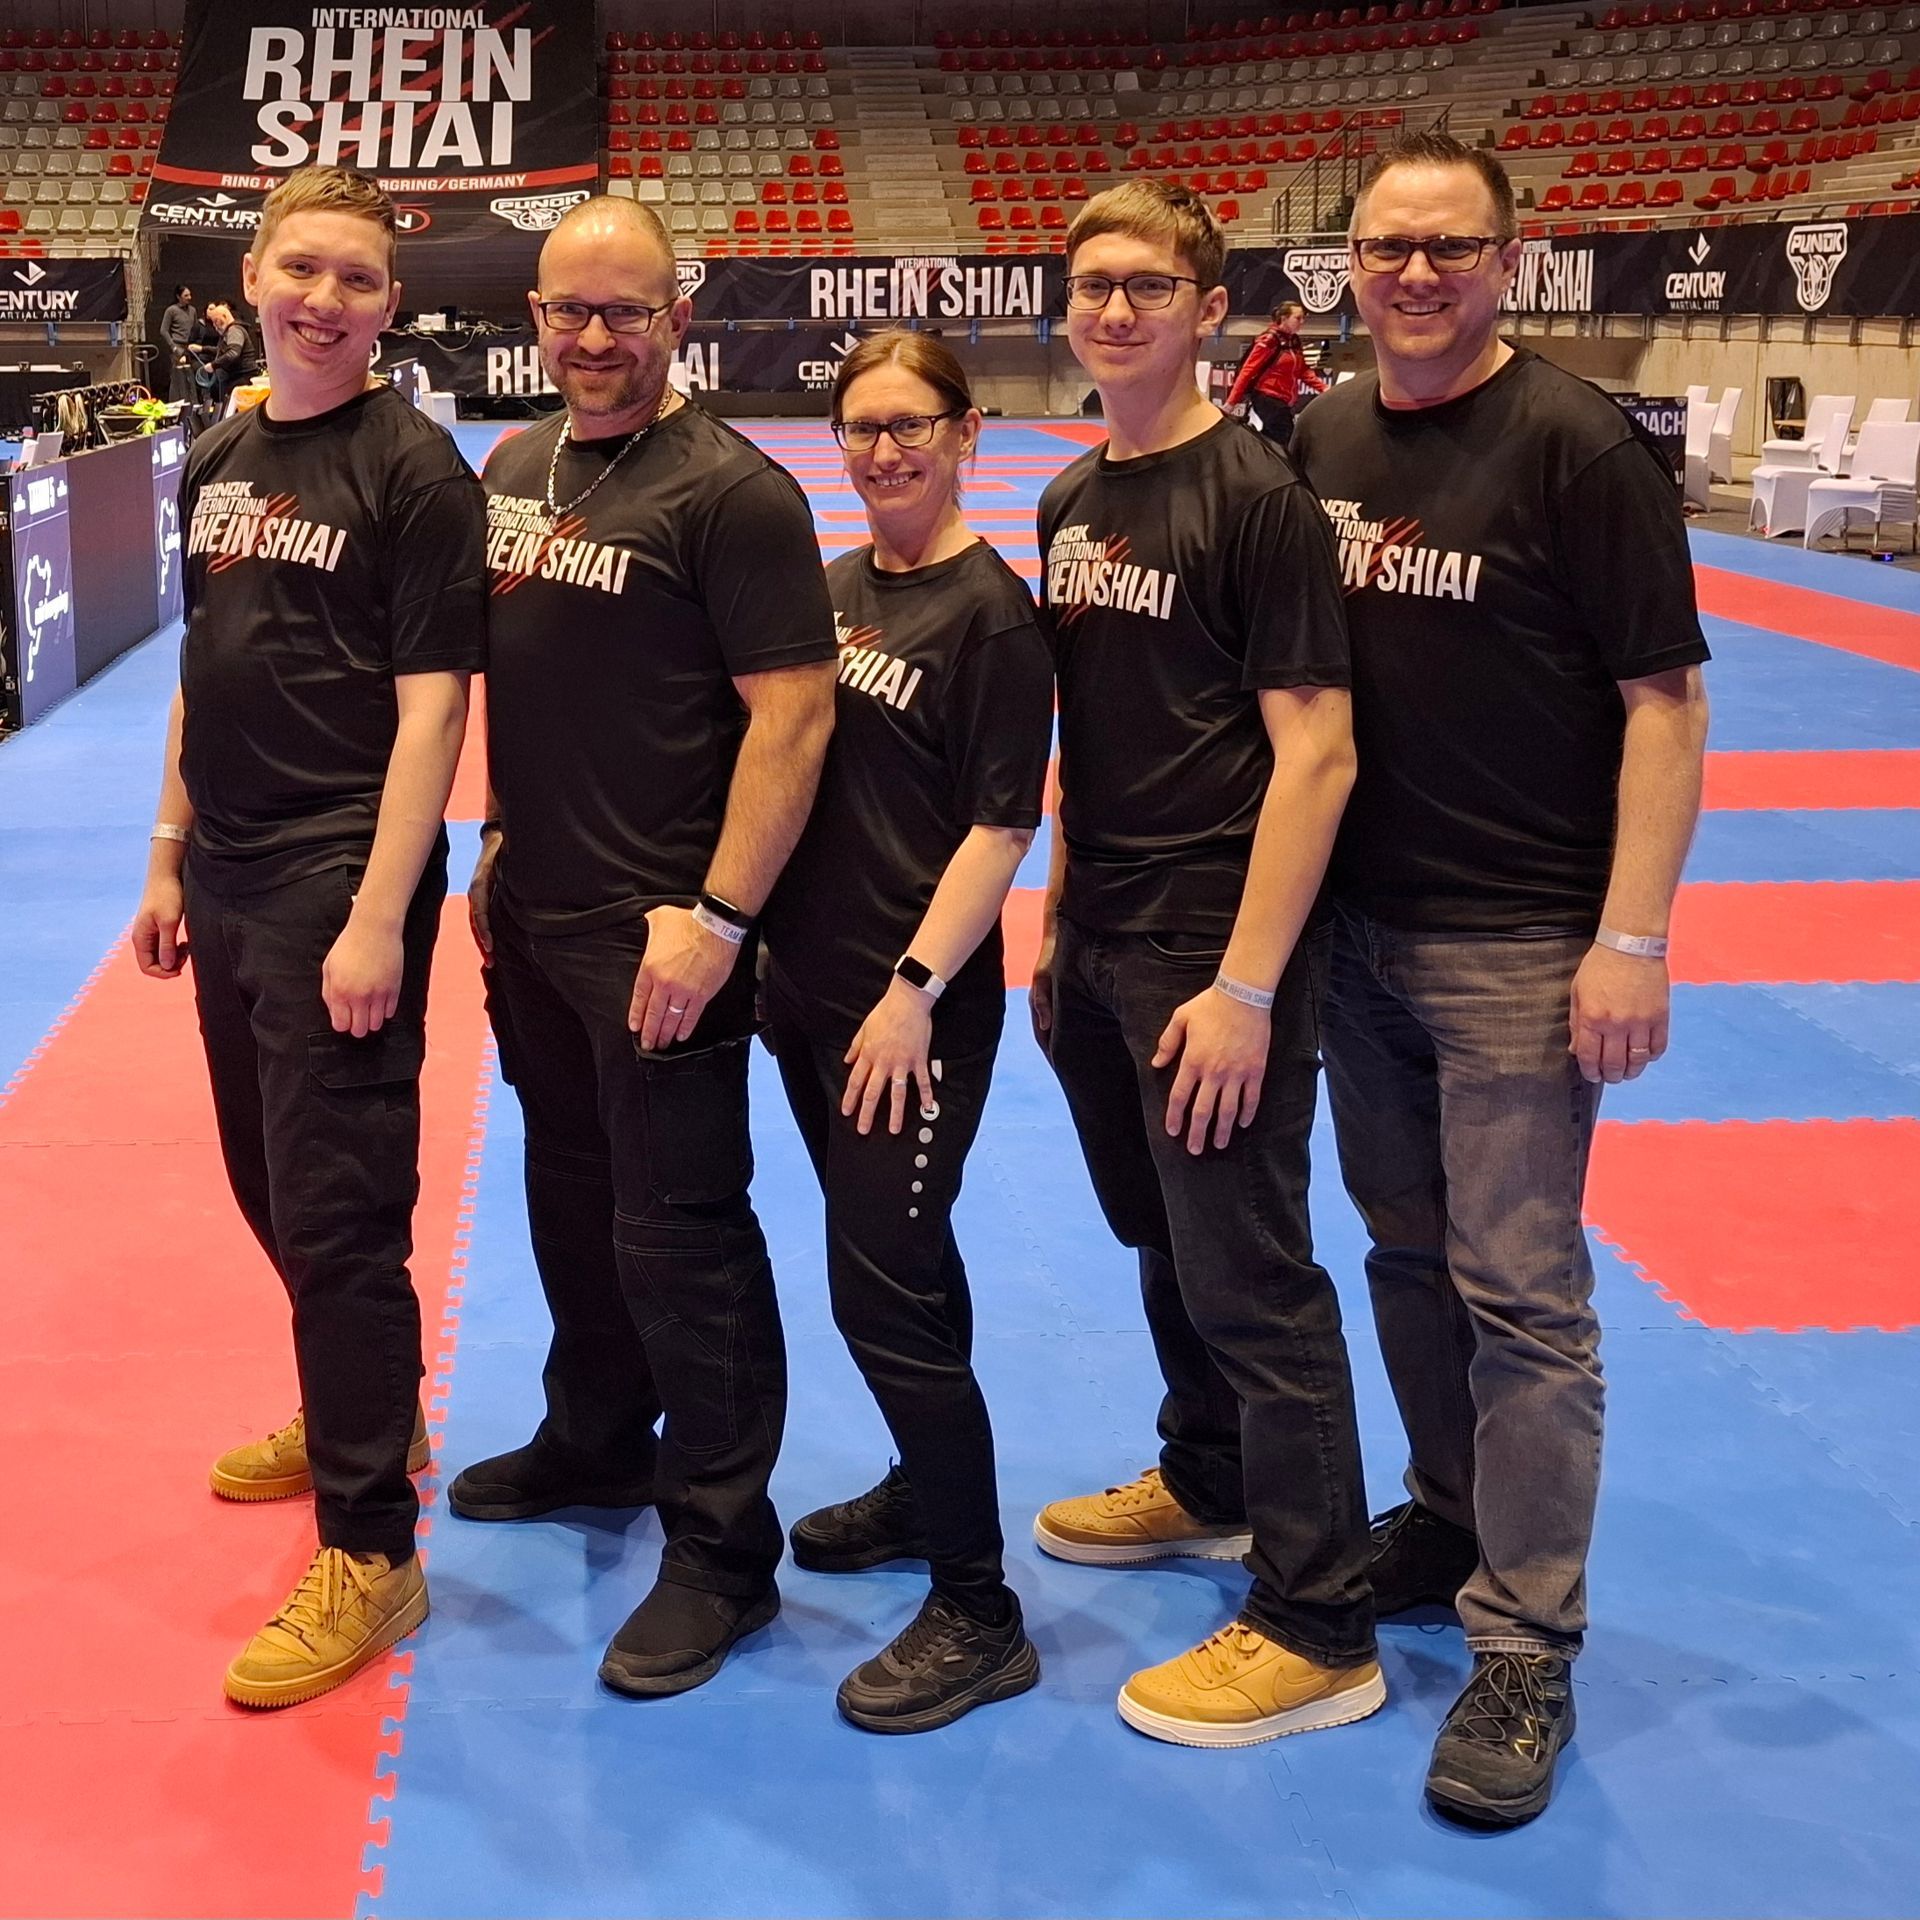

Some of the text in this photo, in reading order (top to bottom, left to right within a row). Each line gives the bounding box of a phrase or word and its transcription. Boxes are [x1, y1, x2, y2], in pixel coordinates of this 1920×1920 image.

[311, 8, 490, 29] INTERNATIONAL
[243, 27, 532, 102] RHEIN
[251, 101, 513, 168] SHIAI
[220, 174, 261, 189] RING
[378, 174, 527, 192] RGRING/GERMANY
[160, 217, 220, 228] MARTIAL
[1790, 232, 1843, 254] PUNOK
[895, 257, 959, 269] INTERNATIONAL
[1541, 249, 1594, 311] SHIAI
[1666, 271, 1726, 299] CENTURY
[0, 290, 79, 310] ENTURY
[810, 266, 1043, 318] RHEIN SHIAI
[0, 311, 71, 319] ARTIAL ARTS
[1670, 301, 1720, 311] MARTIAL ARTS
[807, 382, 836, 390] MART
[1633, 411, 1687, 436] OACH
[1320, 499, 1363, 520] NOK
[257, 516, 347, 573] SHIAI
[486, 527, 631, 595] HEIN SHIAI
[1376, 544, 1482, 602] SHIAI
[1048, 560, 1177, 620] HEIN SHIAI
[837, 645, 923, 711] SHIAI
[720, 925, 740, 940] TEAM
